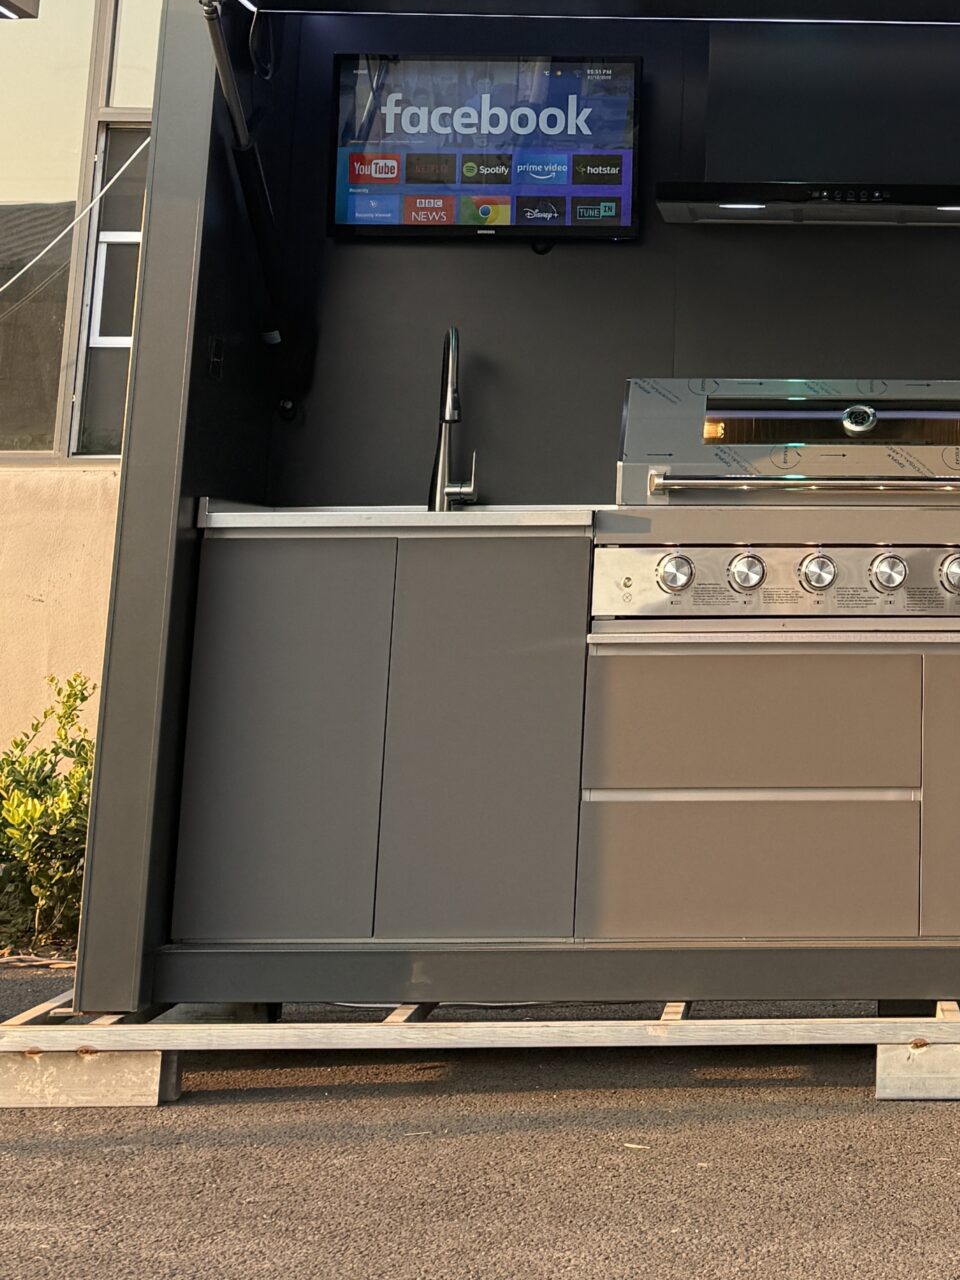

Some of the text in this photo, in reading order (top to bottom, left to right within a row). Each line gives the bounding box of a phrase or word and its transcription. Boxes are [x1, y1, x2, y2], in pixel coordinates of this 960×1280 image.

[381, 93, 593, 135] facebook
[353, 160, 398, 178] YouTube
[479, 165, 509, 176] Spotify
[517, 163, 568, 173] prime video
[587, 165, 620, 174] hotstar
[416, 199, 443, 208] BBC
[523, 204, 560, 221] Disney+
[579, 203, 613, 218] TUNE IN
[411, 211, 447, 222] NEWS
